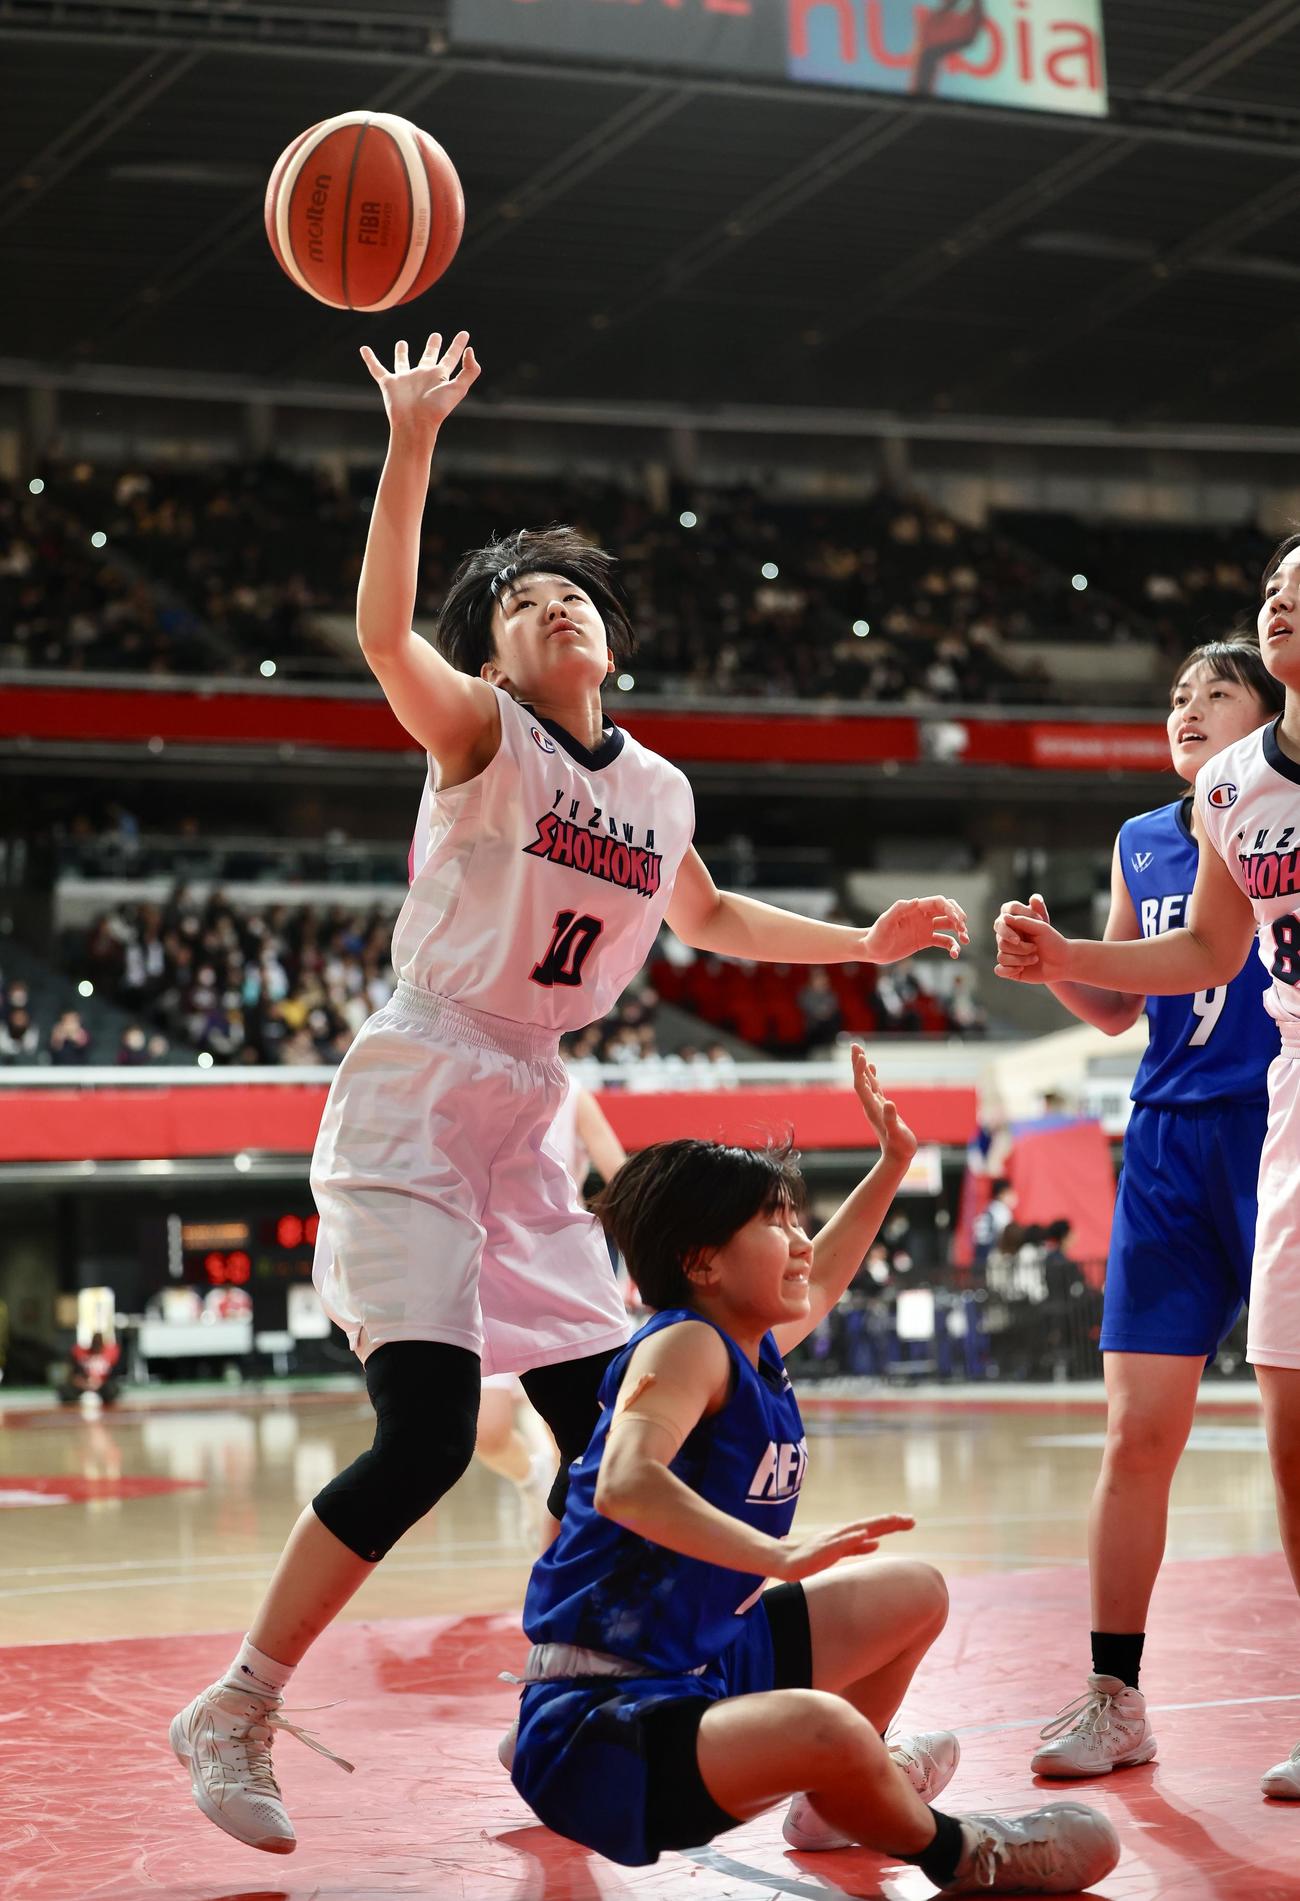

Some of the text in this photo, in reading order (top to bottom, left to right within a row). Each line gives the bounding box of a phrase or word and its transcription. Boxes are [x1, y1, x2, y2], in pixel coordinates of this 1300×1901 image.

[789, 0, 1098, 90] nubia
[307, 174, 332, 263] molten
[358, 201, 381, 246] FIBA
[552, 789, 655, 849] YUZAWA
[521, 811, 663, 899] SHOHOKU
[1238, 847, 1300, 900] HOH
[528, 909, 604, 989] 10
[1188, 983, 1228, 1046] 9
